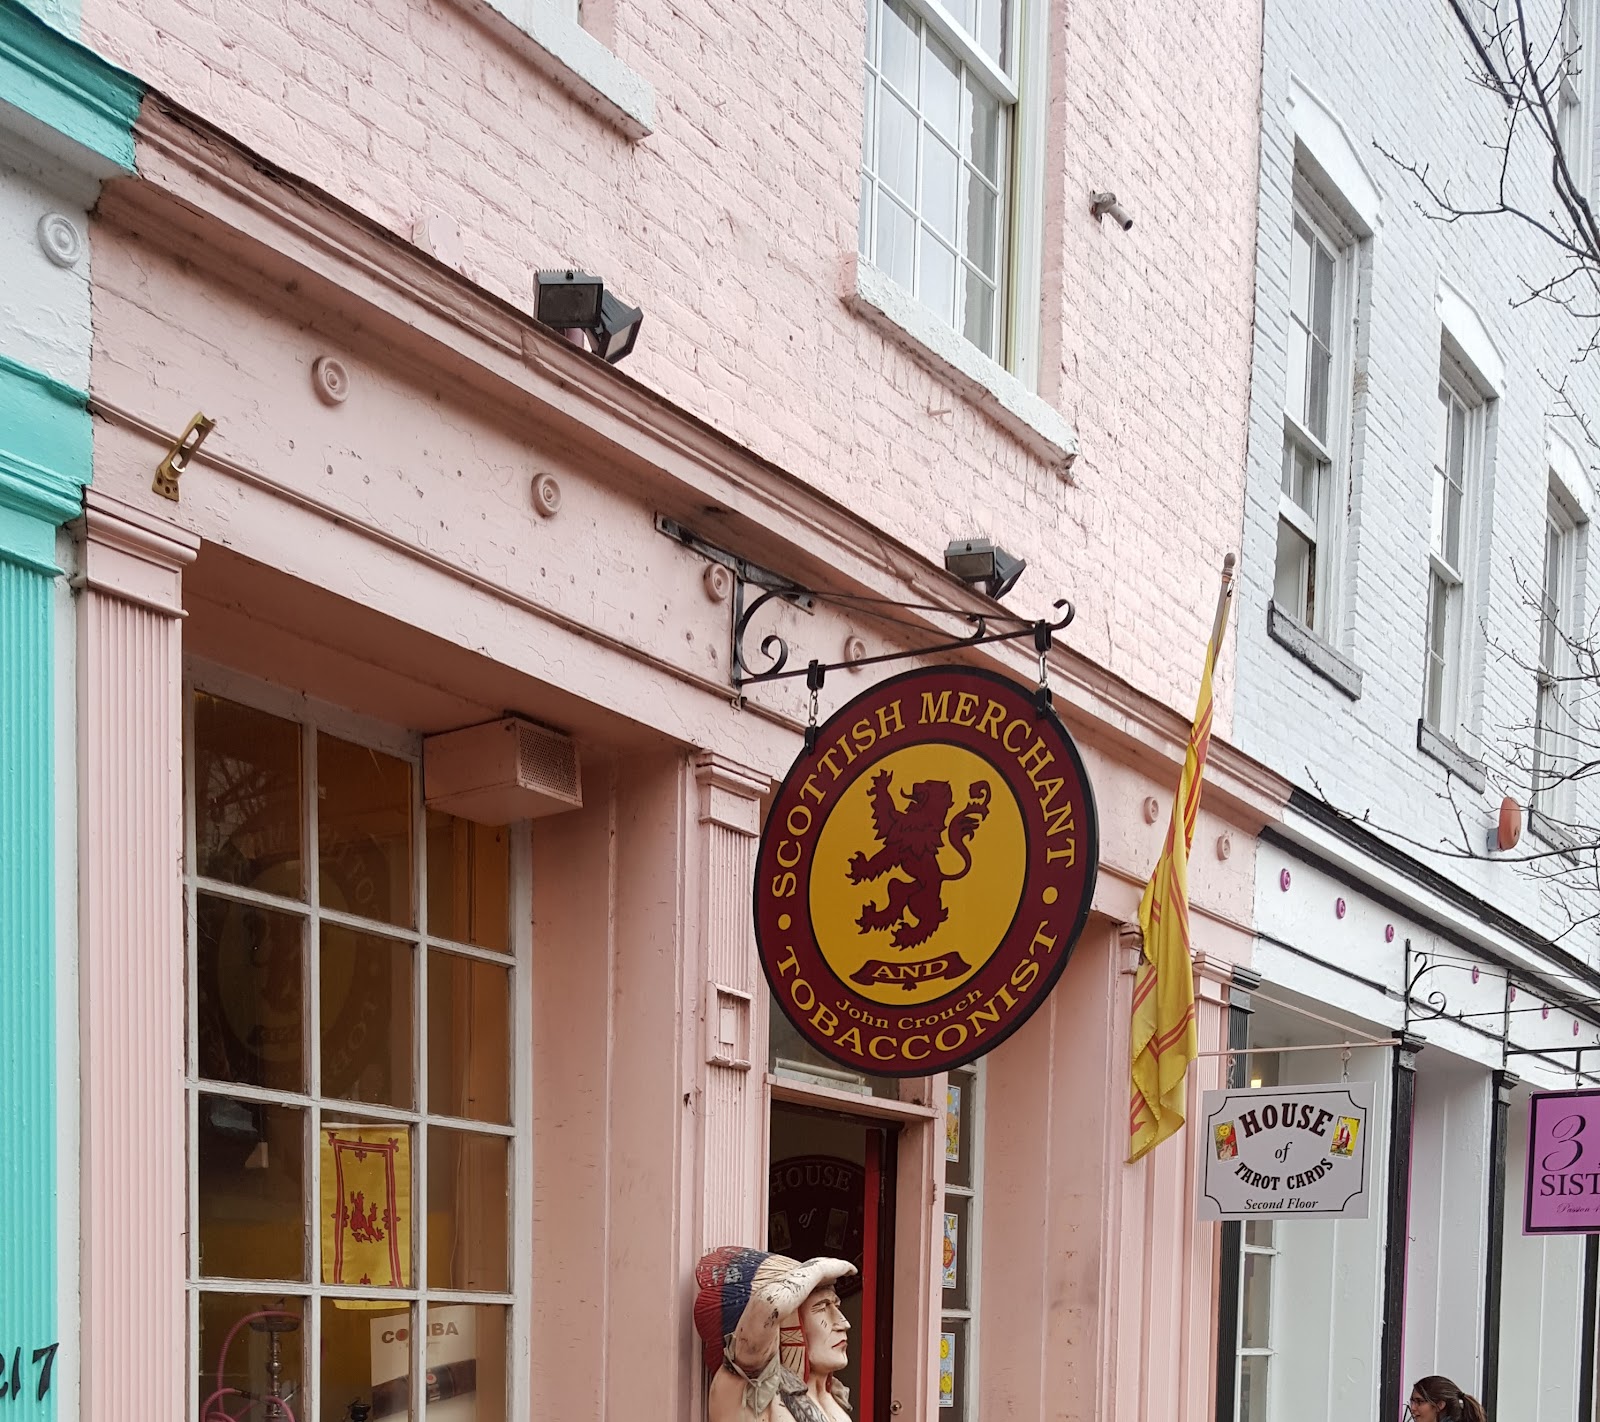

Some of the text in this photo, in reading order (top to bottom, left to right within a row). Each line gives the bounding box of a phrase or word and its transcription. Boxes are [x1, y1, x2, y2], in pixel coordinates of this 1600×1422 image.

[772, 690, 1075, 898] SCOTTISH MERCHANT
[872, 959, 949, 980] AND
[777, 920, 1059, 1061] TOBACCONIST
[836, 989, 984, 1031] John Crouch
[1239, 1103, 1334, 1138] HOUSE
[1275, 1142, 1293, 1163] of
[1542, 1114, 1586, 1171] 3
[1234, 1158, 1333, 1190] TAROT CARDS
[799, 1208, 817, 1228] of
[1244, 1198, 1319, 1210] Second Floor
[381, 1321, 459, 1344] COIBA
